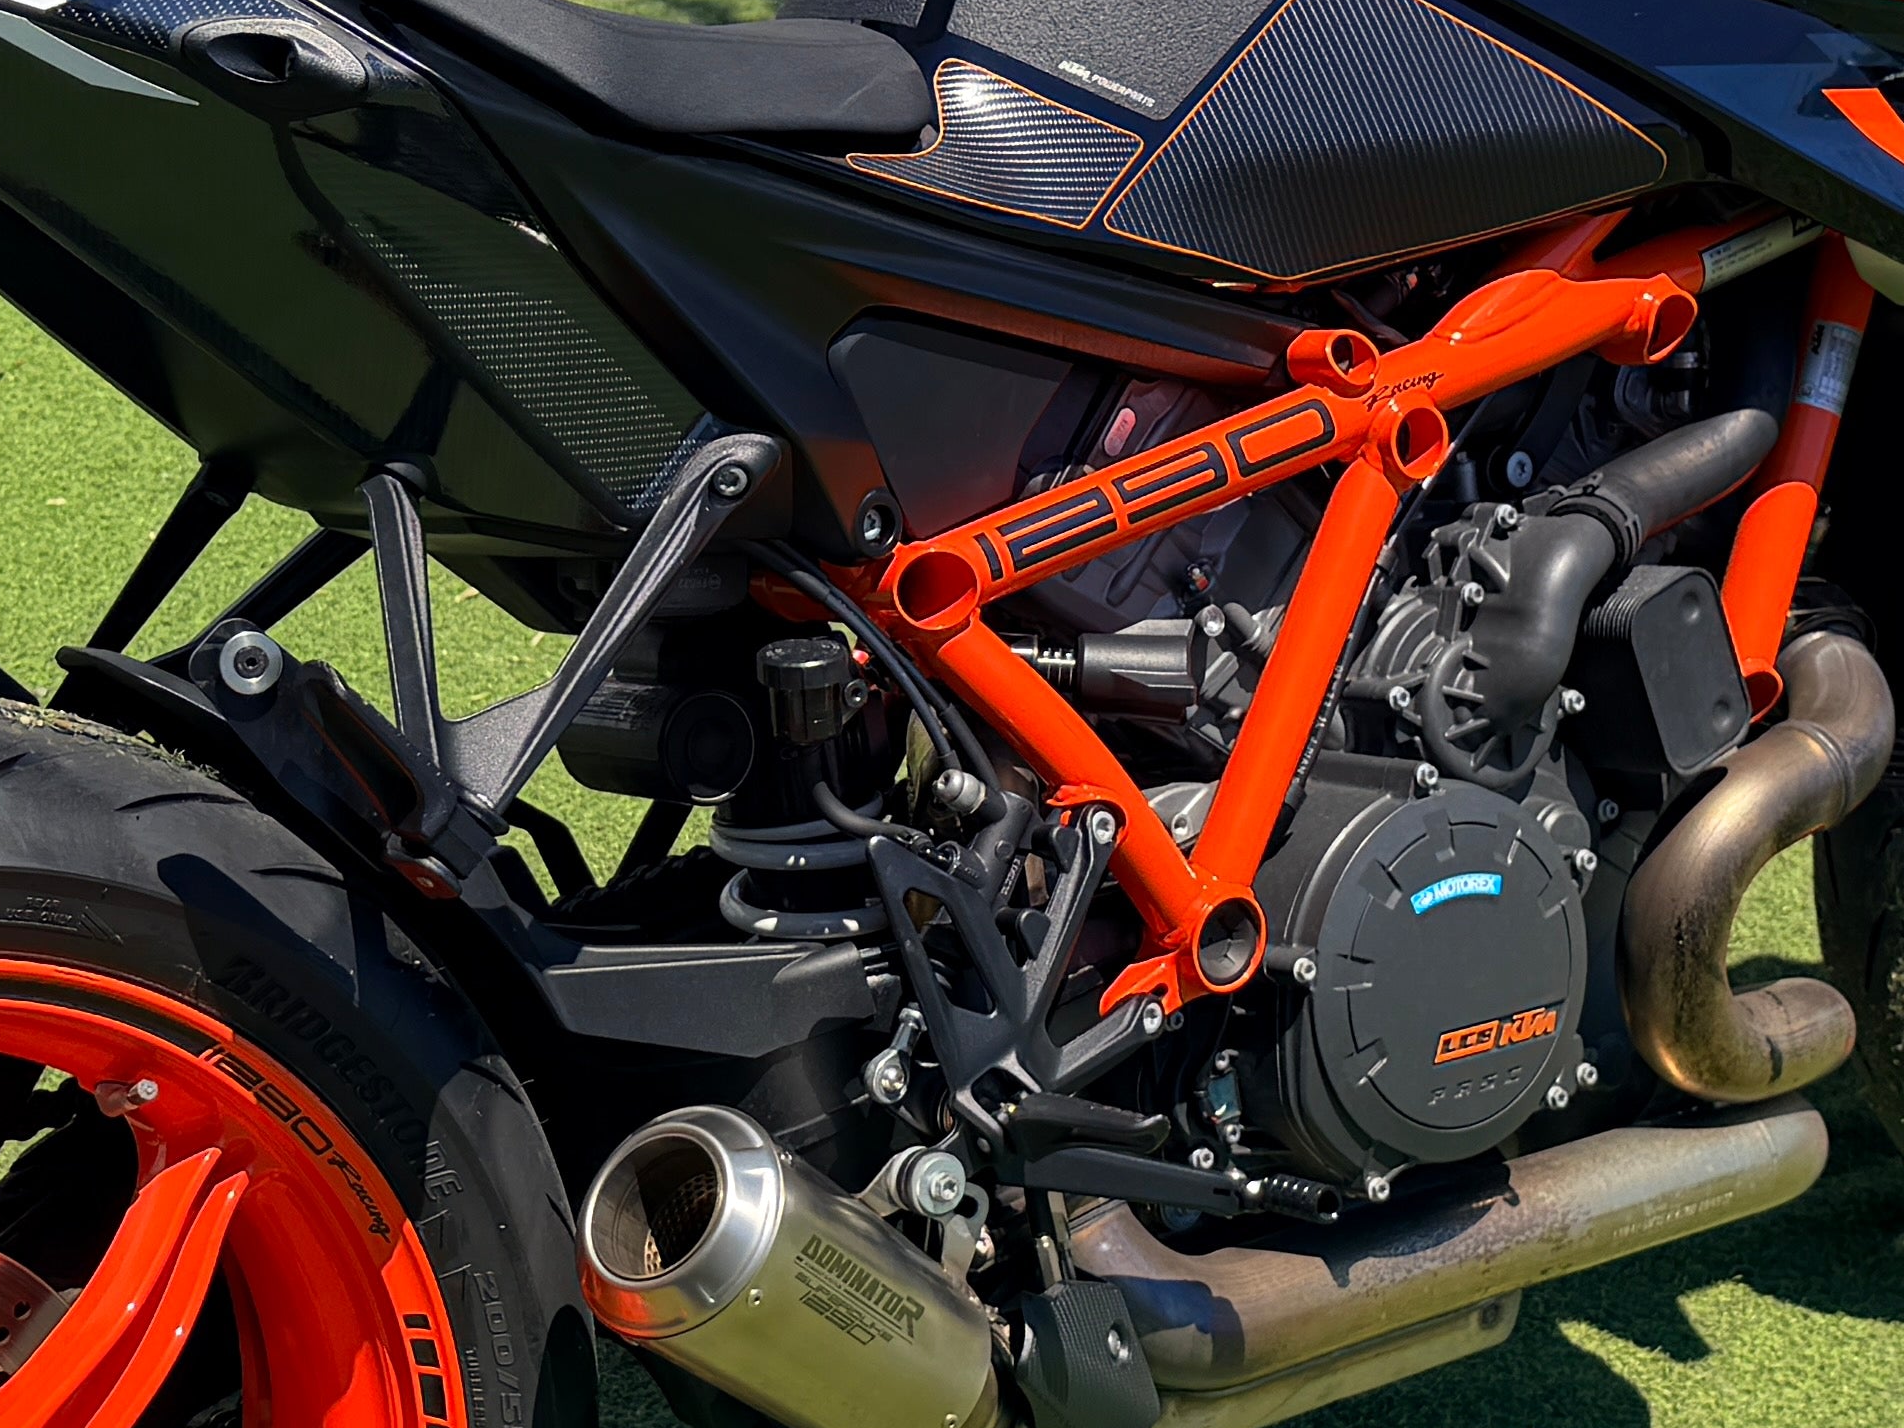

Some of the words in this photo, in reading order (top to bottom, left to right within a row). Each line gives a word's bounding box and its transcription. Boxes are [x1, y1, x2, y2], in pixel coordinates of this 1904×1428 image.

[976, 398, 1337, 582] 1290
[1366, 369, 1446, 412] Racing
[1433, 873, 1496, 901] MOTOREX
[214, 950, 467, 1210] BRIDGESTONE
[1498, 1006, 1559, 1048] KTM
[202, 1047, 334, 1160] 1290
[326, 1151, 393, 1243] Racing
[800, 1233, 925, 1339] DOMINATOR
